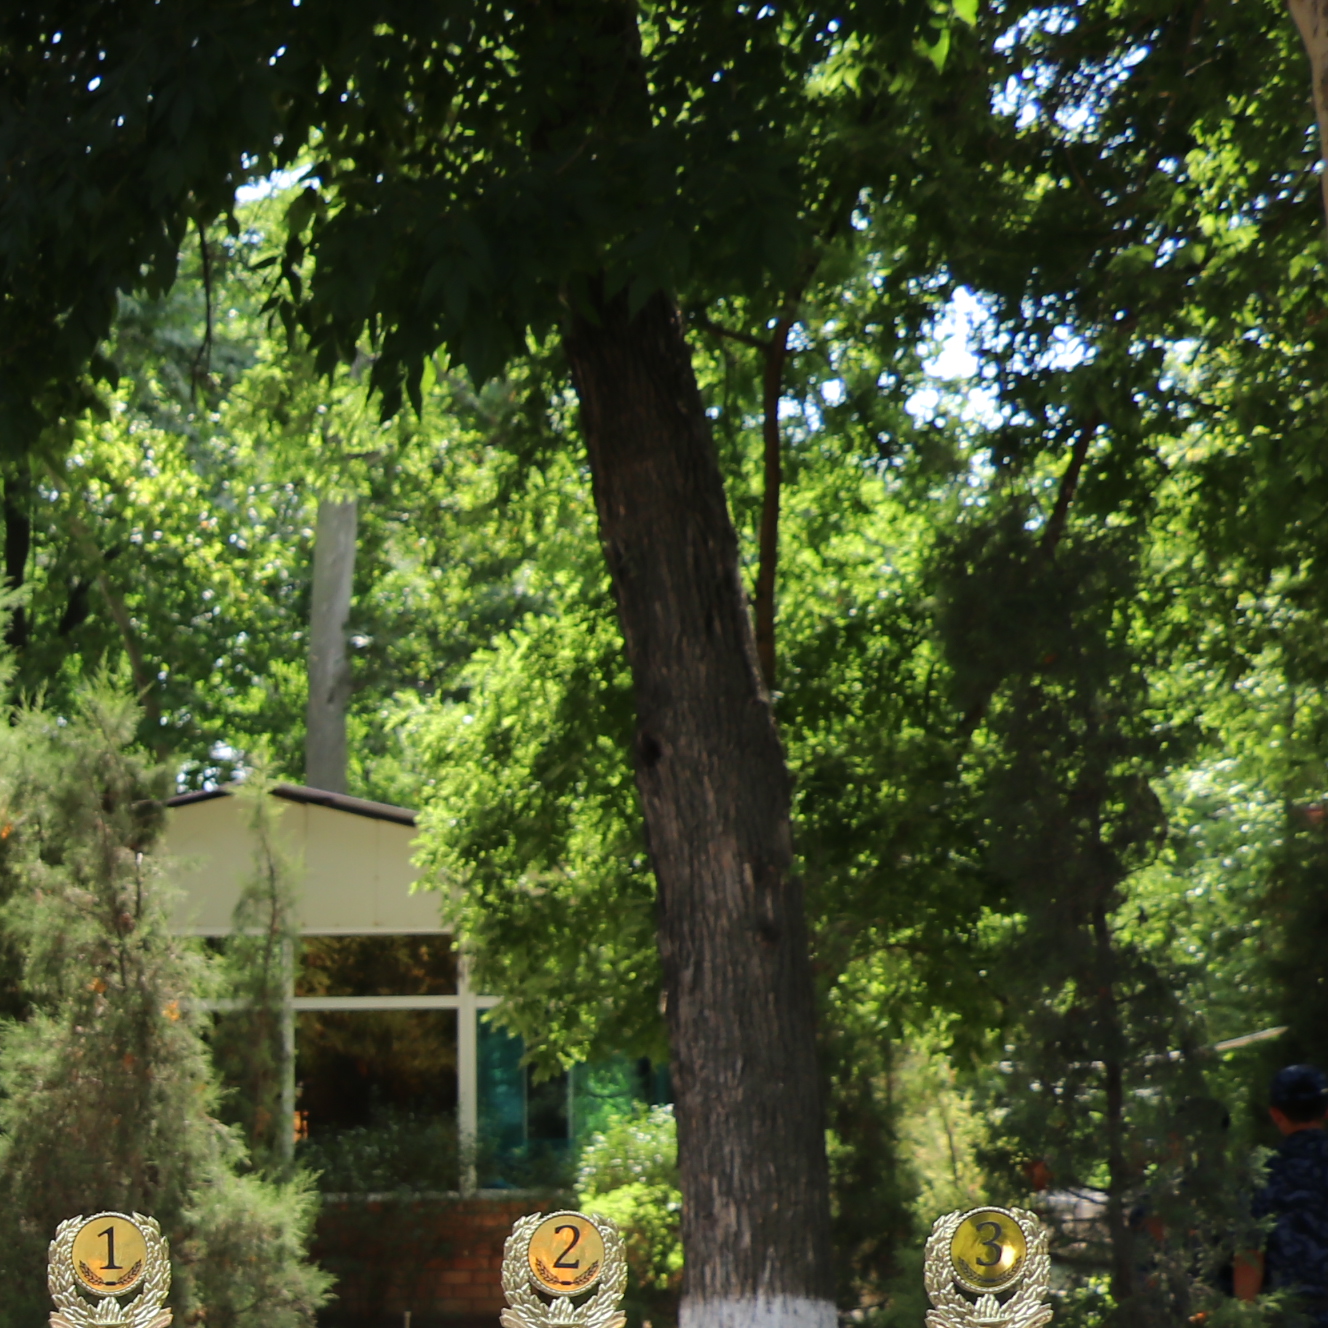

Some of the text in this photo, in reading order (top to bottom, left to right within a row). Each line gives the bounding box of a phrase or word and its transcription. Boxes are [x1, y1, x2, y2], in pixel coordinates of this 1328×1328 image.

[97, 1226, 123, 1270] 1
[552, 1224, 580, 1269] 2
[975, 1221, 1002, 1266] 3
